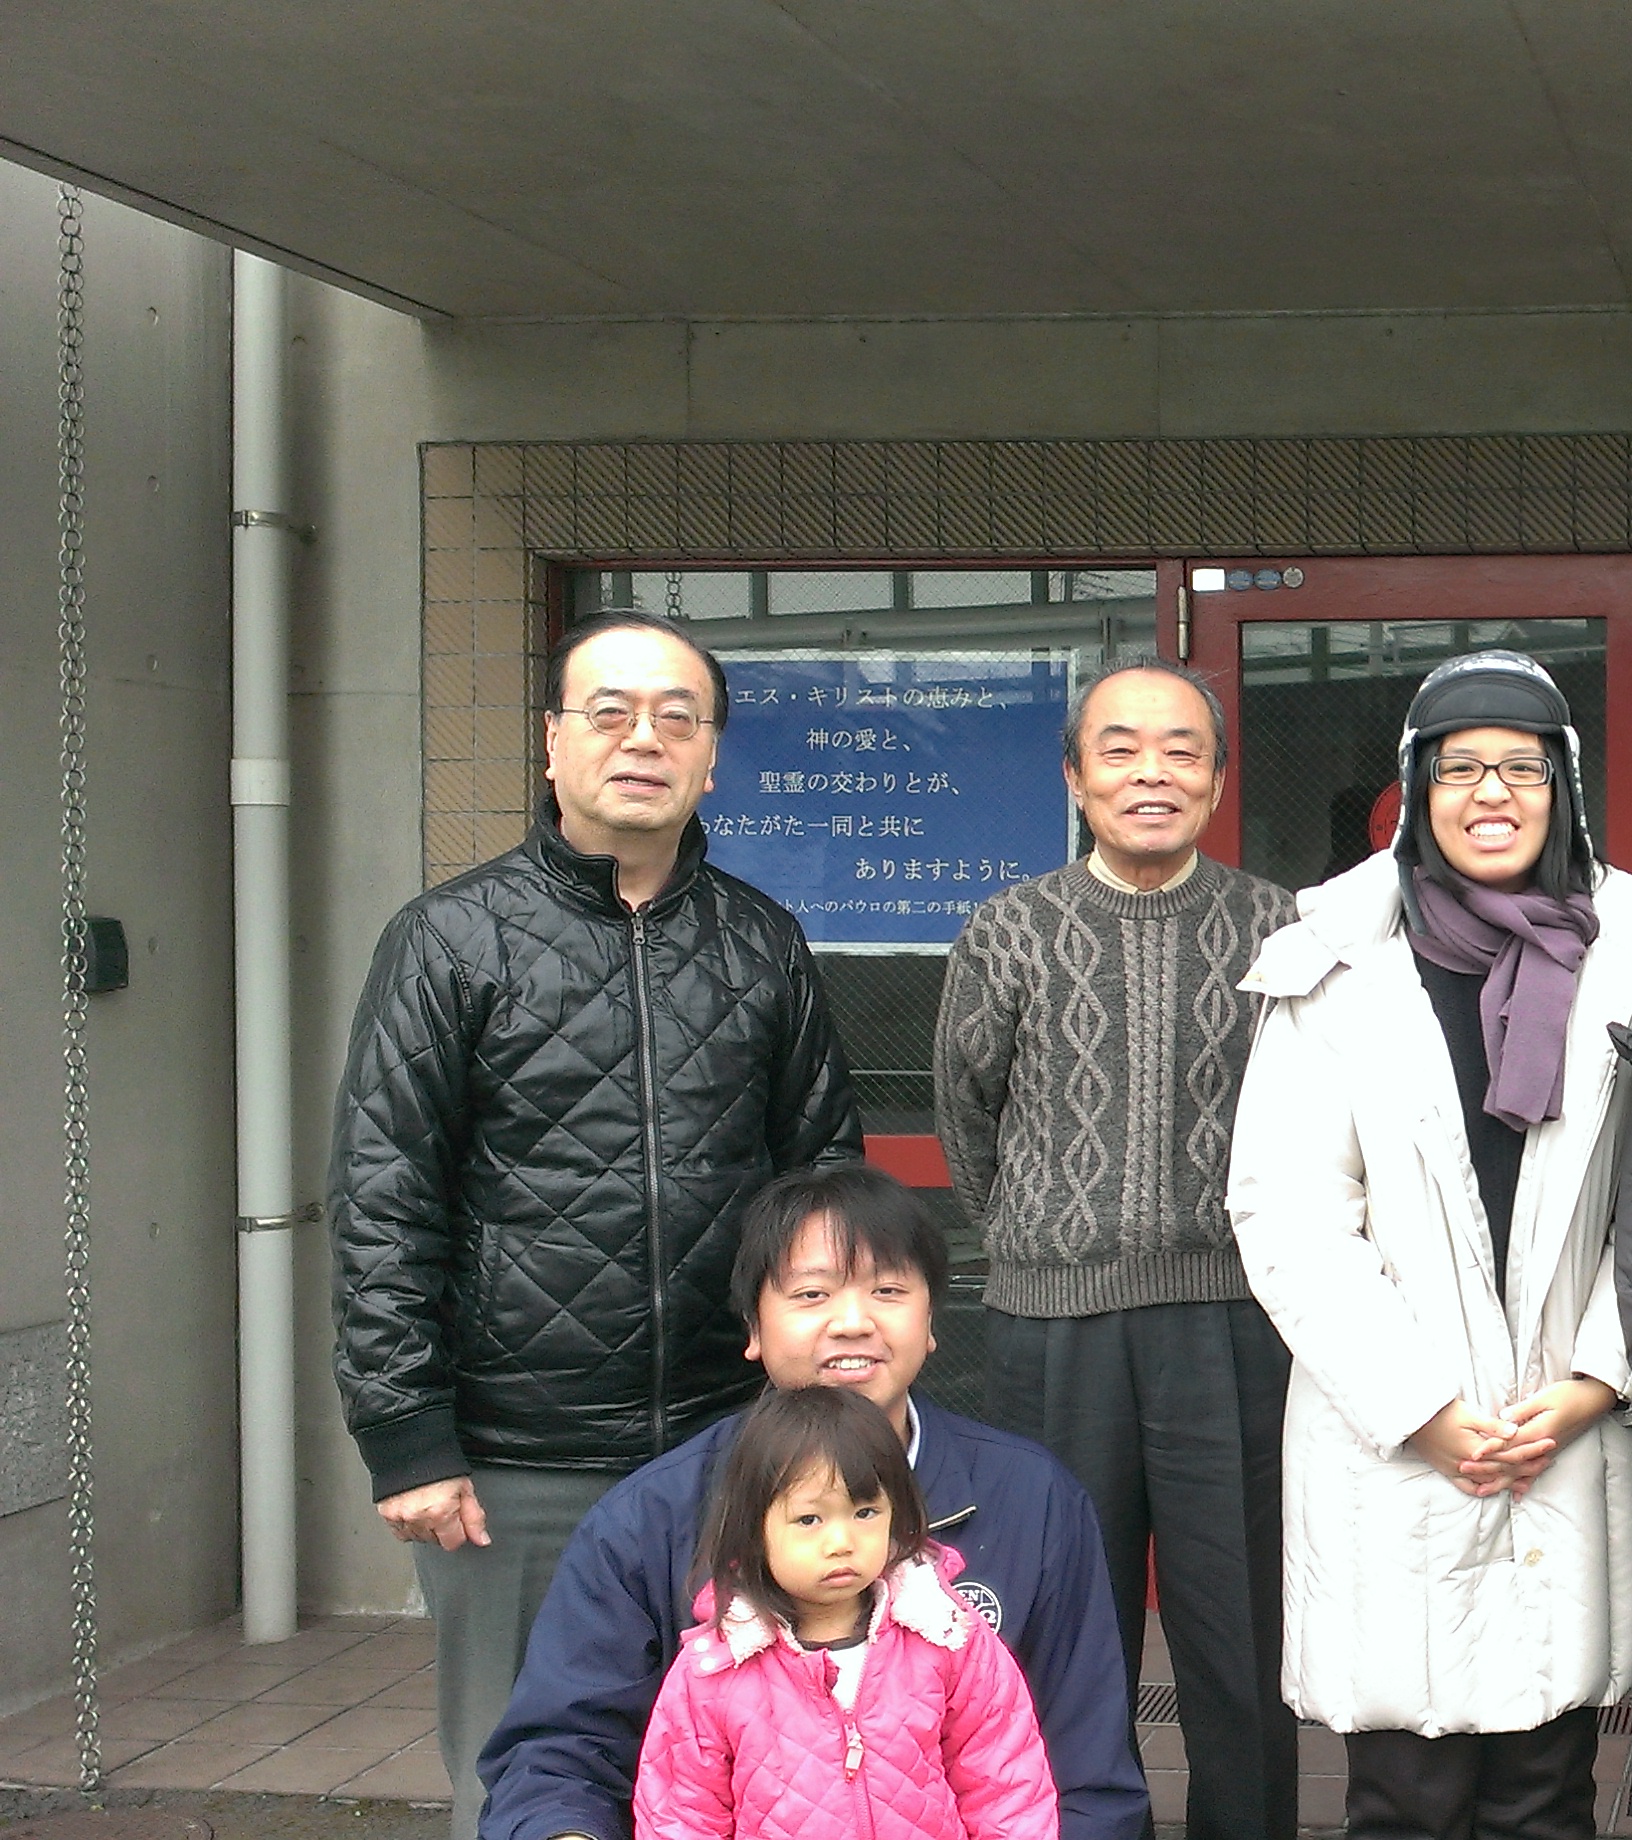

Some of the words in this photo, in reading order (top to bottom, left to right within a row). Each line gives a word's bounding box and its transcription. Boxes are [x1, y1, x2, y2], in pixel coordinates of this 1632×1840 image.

[726, 686, 1008, 711] エス・キリストの恵みと、
[806, 728, 912, 752] 神の愛と、
[759, 770, 960, 796] 聖霊の交わりとが、
[855, 858, 1032, 883] ありますように。
[777, 899, 979, 916] ト人へのパウロの第二の手紙
